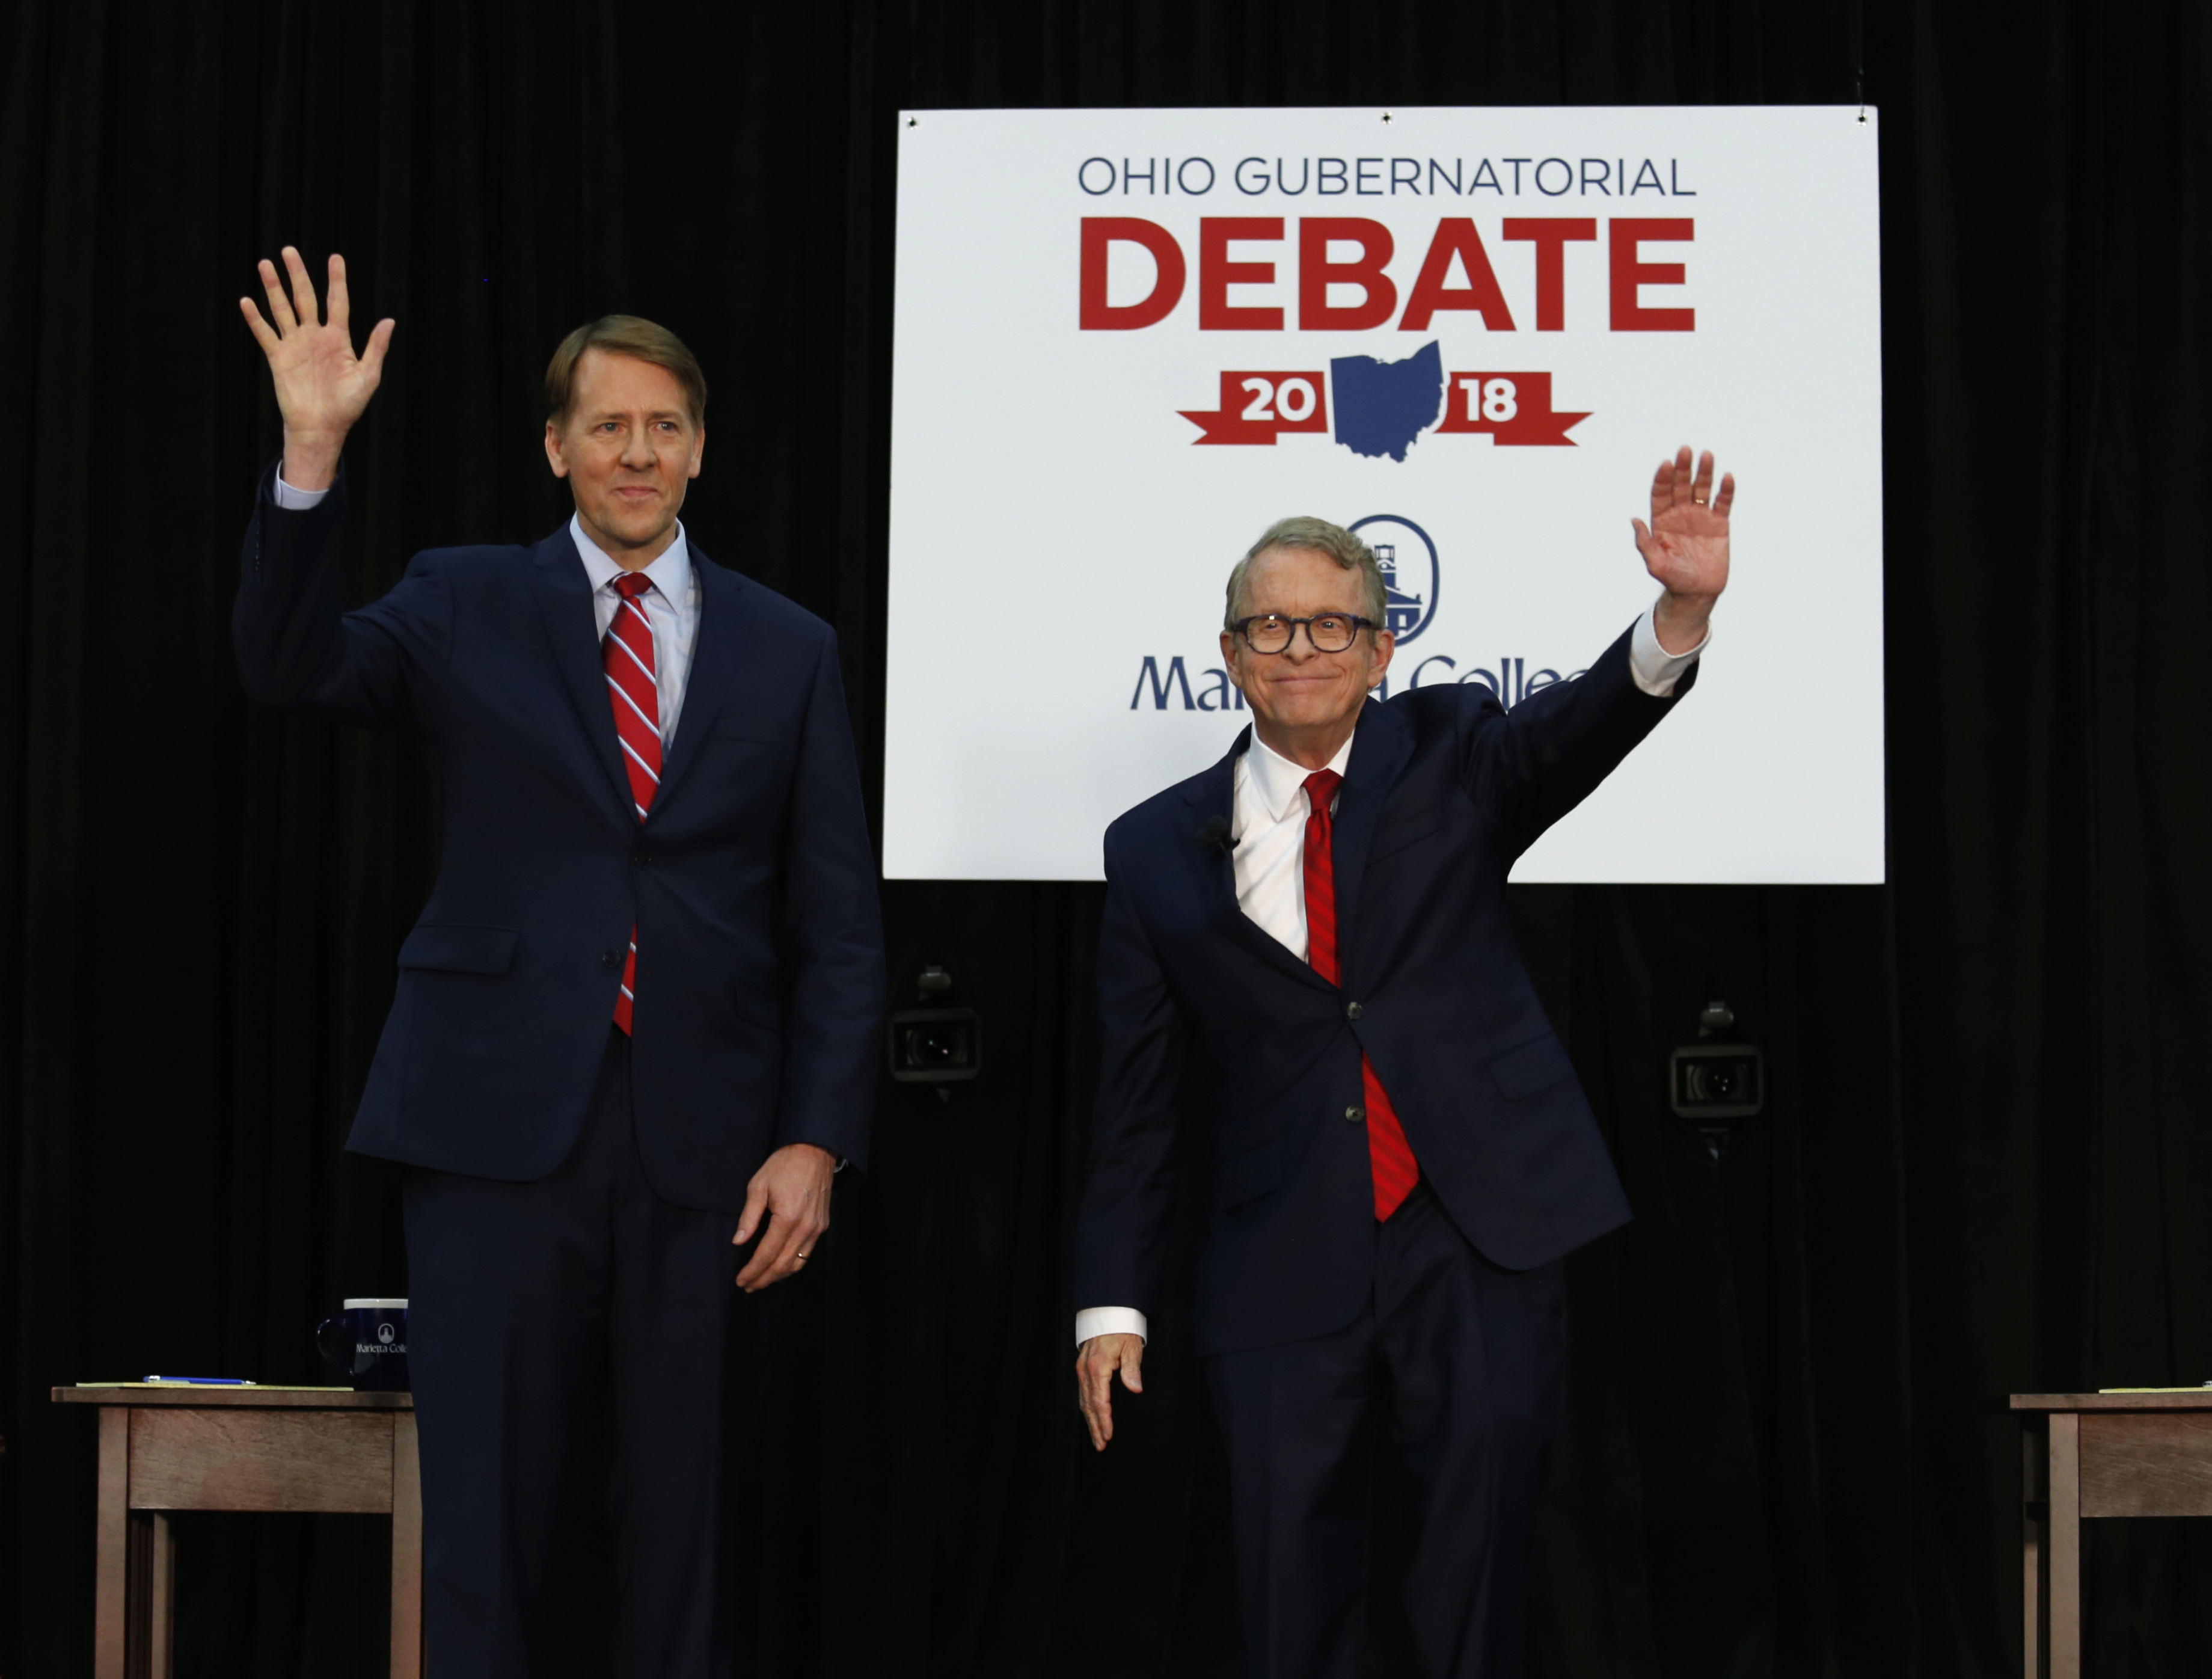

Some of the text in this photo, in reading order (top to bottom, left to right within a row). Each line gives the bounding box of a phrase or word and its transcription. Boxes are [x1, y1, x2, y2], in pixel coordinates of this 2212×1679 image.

[1078, 156, 1697, 197] OHIO GUBERNATORIAL
[1079, 216, 1696, 332] DEBATE
[1240, 377, 1518, 422] 20 18
[1409, 655, 1589, 711] Colle
